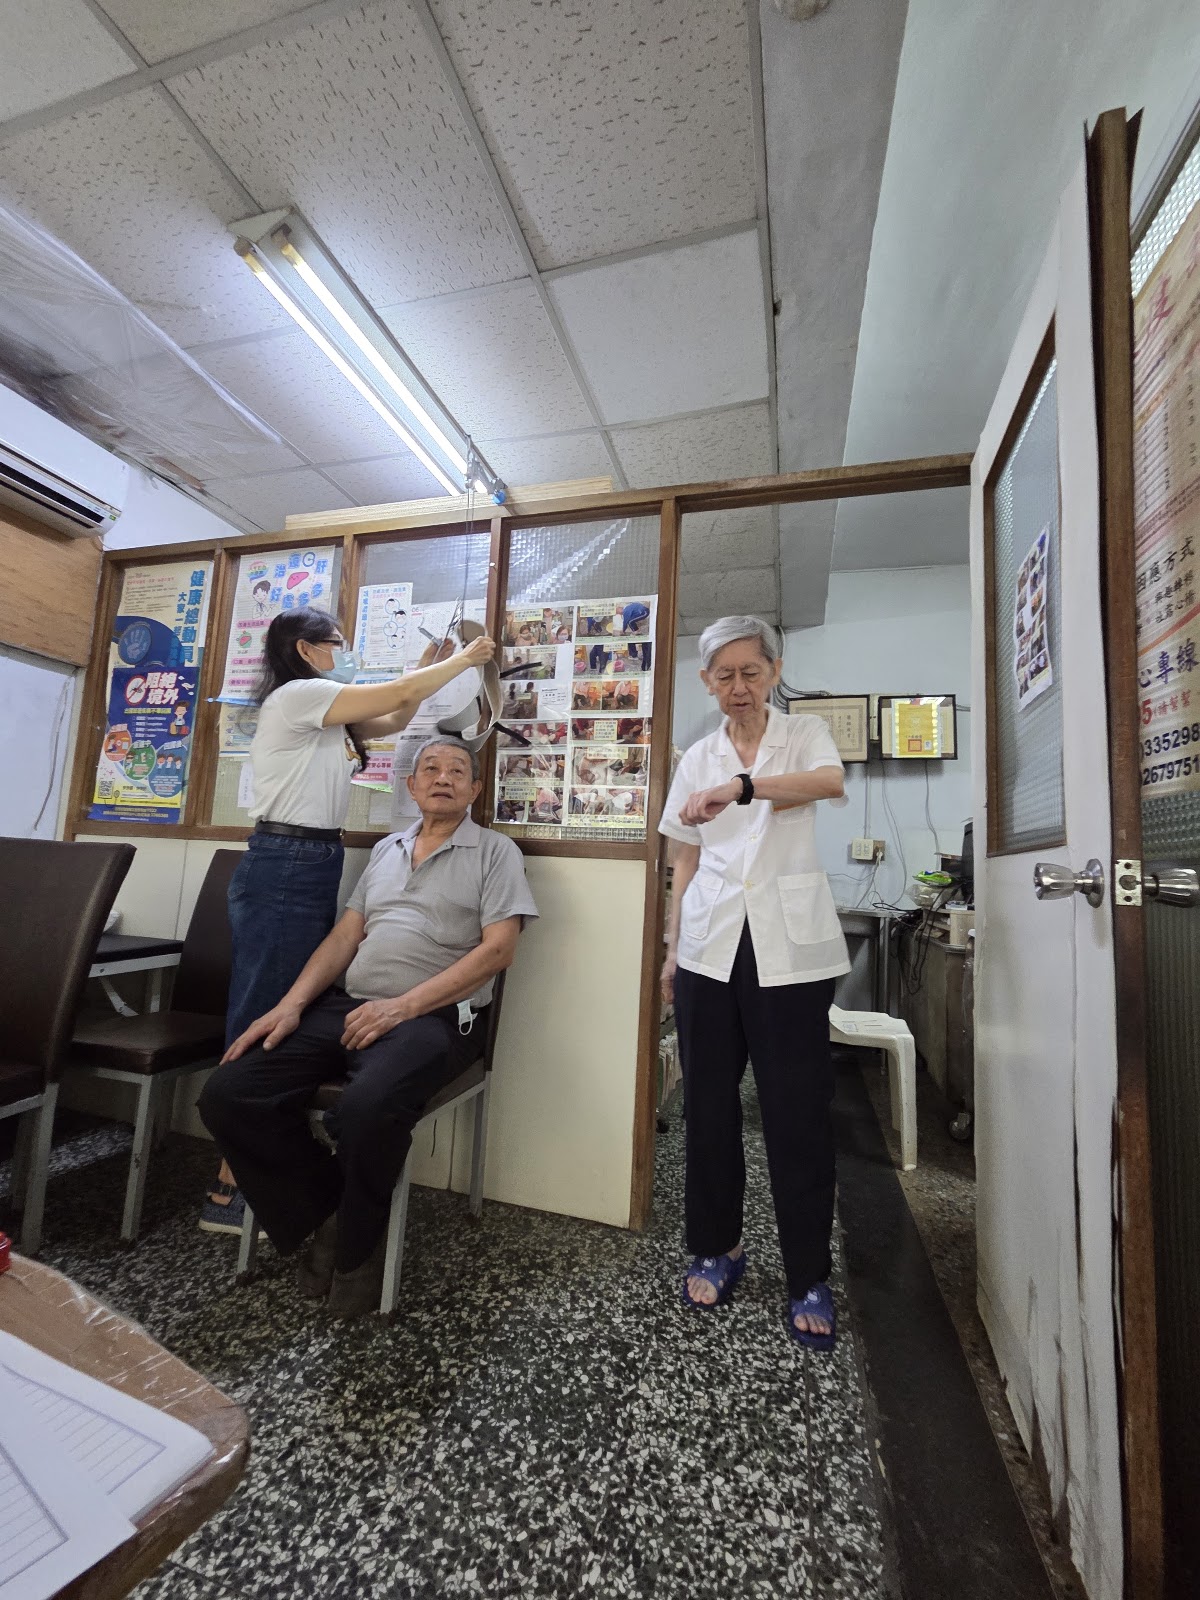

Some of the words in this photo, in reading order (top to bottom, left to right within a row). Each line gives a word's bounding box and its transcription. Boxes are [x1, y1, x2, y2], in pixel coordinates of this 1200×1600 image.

[269, 582, 324, 610] 好處多多
[180, 569, 206, 663] 健康總動員
[1137, 638, 1199, 688] 心專線
[145, 672, 178, 689] 阻絕
[146, 688, 179, 705] 境外
